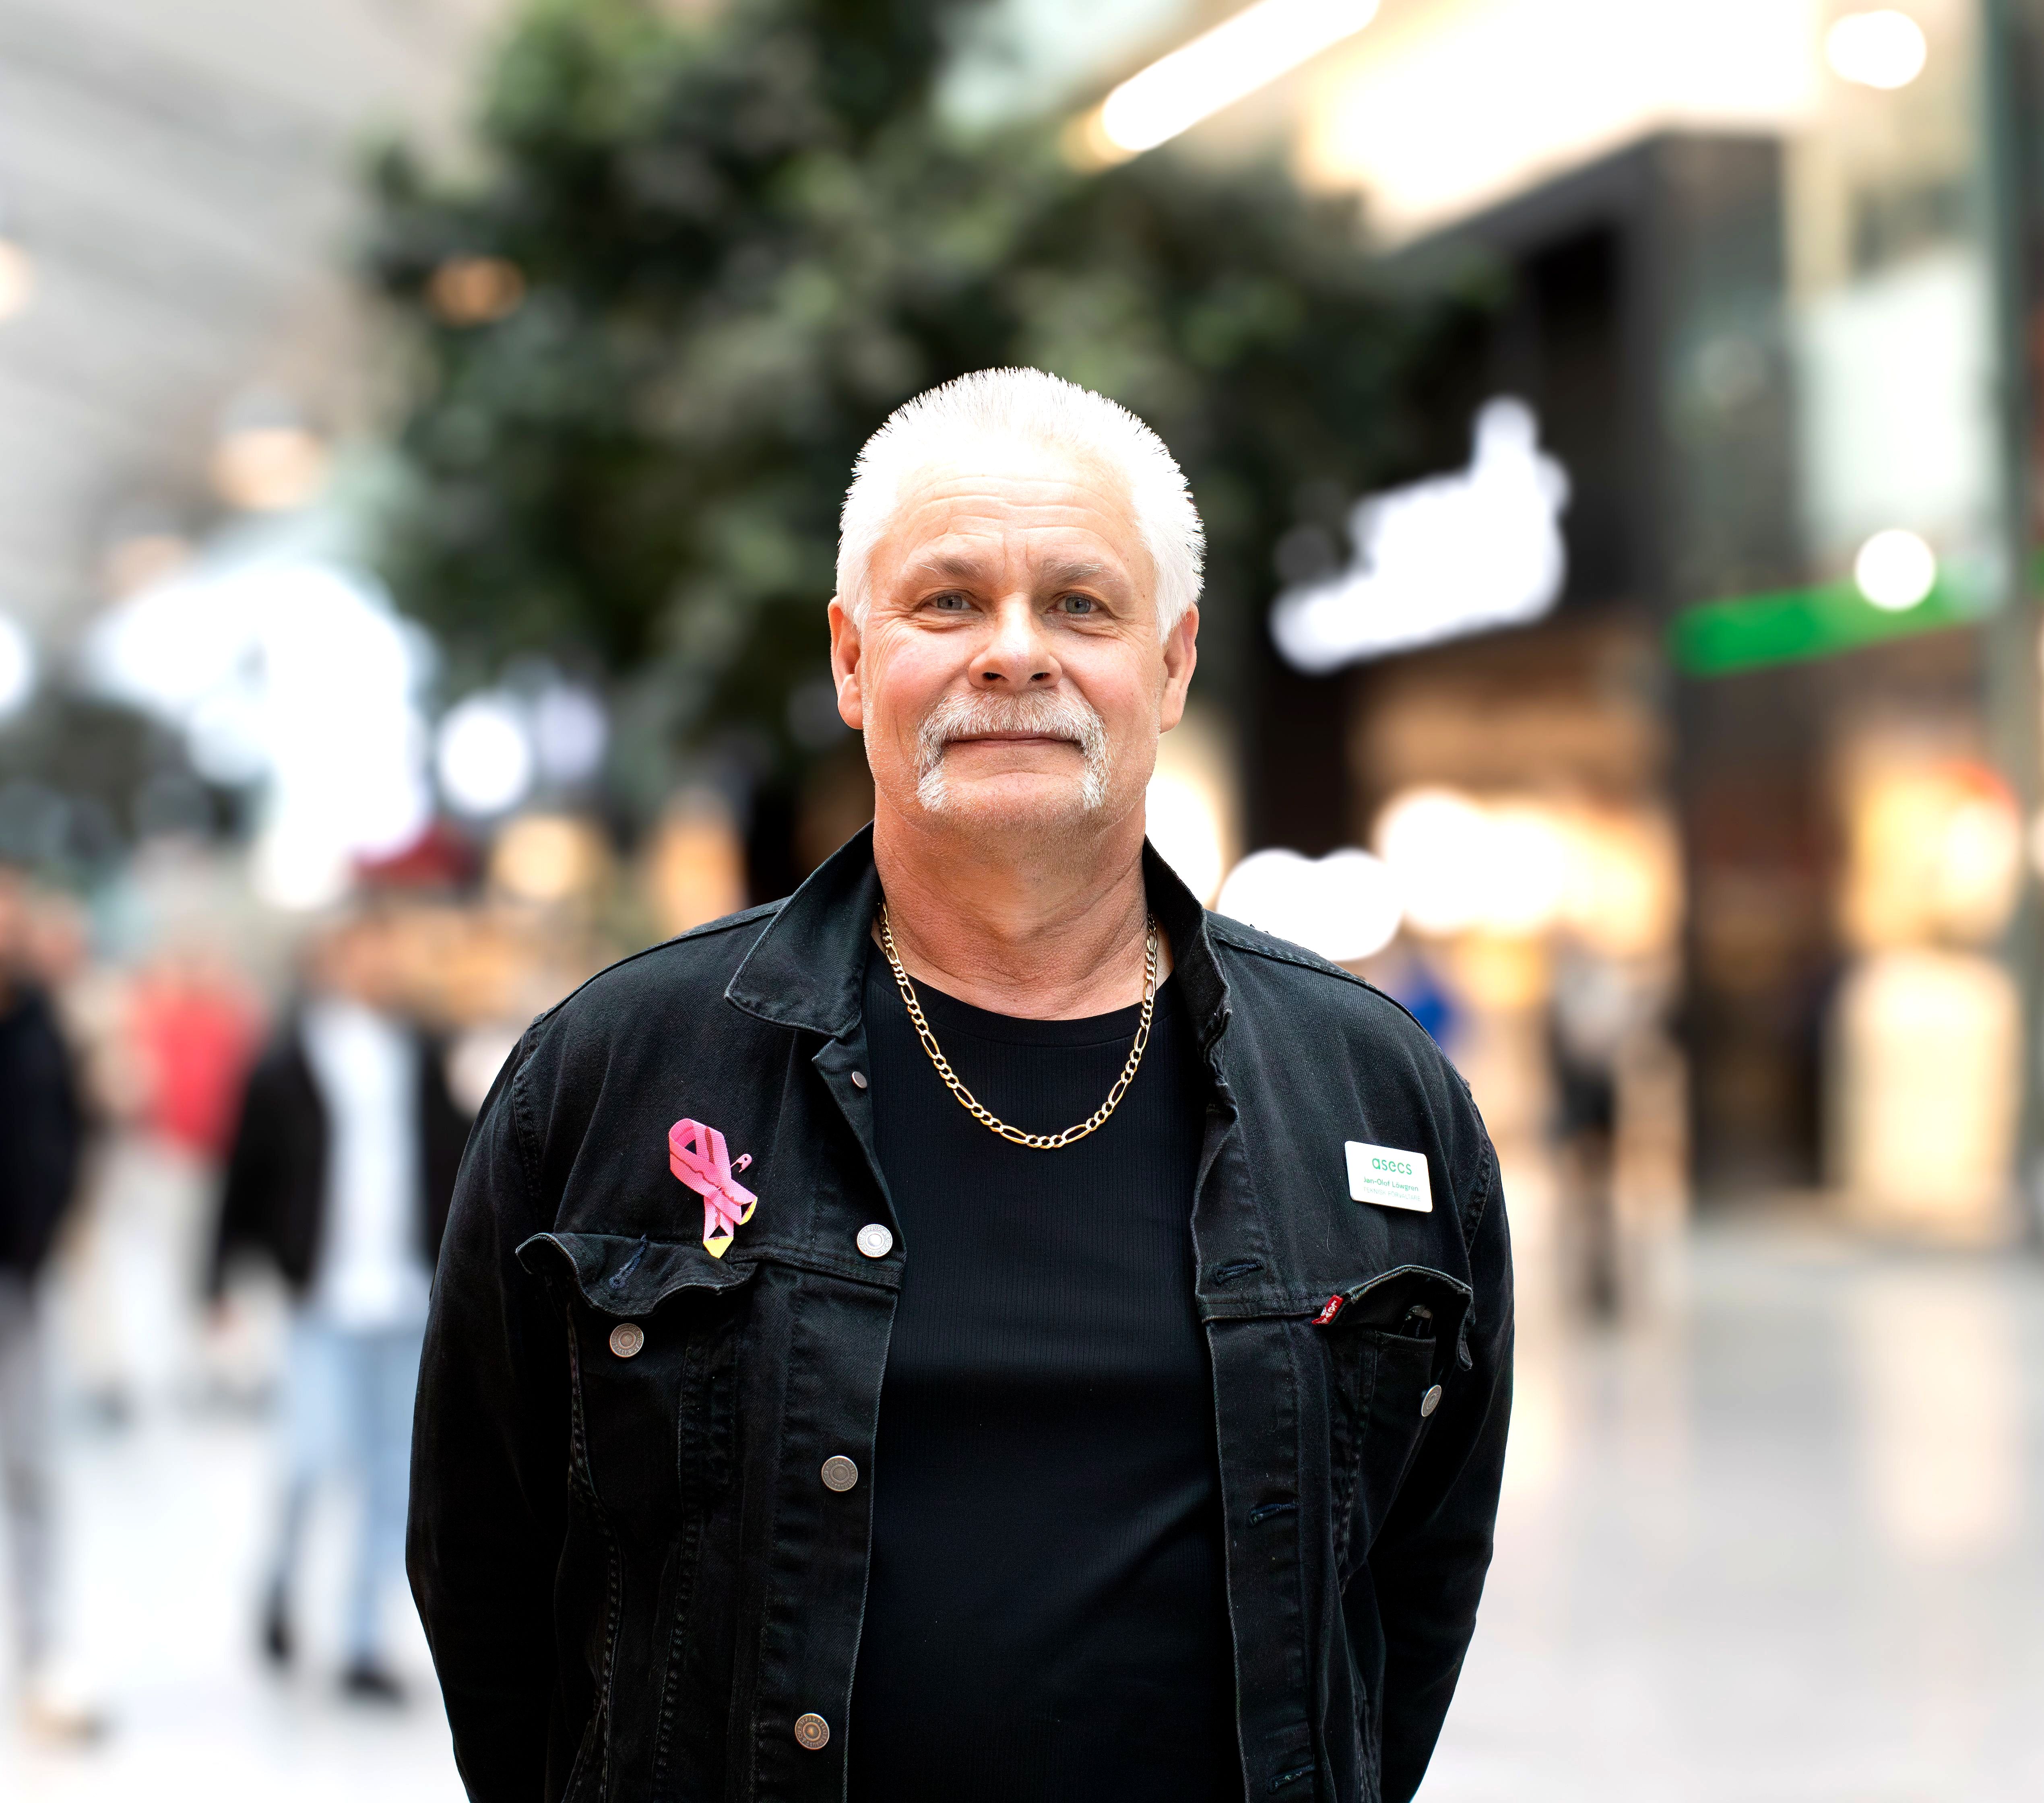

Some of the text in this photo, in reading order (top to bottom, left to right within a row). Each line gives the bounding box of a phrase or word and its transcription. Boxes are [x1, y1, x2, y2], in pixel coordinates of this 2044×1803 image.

[1372, 1158, 1412, 1175] asecs
[1363, 1176, 1419, 1191] Jan-Olof Löwgren
[1363, 1187, 1386, 1195] TEKNISK
